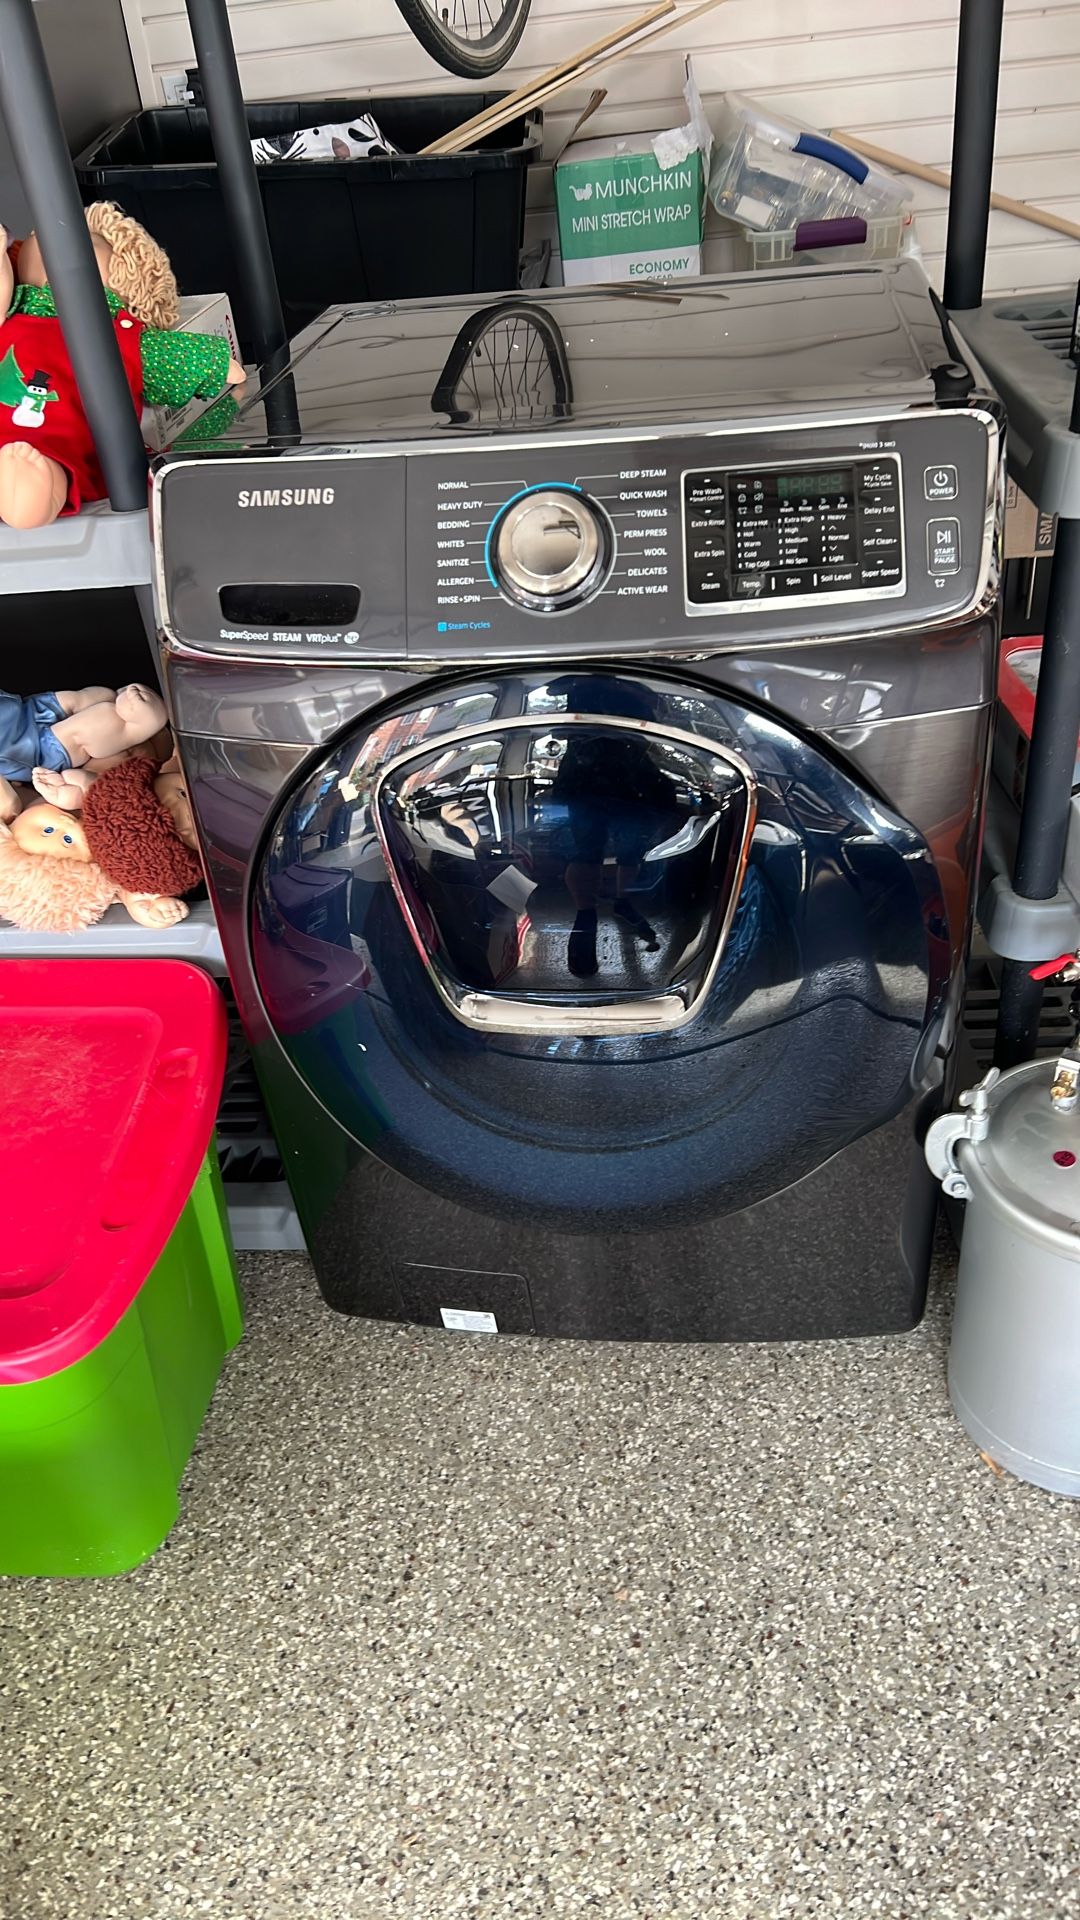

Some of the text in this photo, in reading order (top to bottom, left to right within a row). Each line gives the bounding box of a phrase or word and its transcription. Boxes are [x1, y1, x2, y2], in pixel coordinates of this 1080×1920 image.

[595, 170, 692, 199] MUNCHKIN
[572, 204, 692, 233] MINI STRETCH WRAP
[629, 258, 690, 275] ECONOMY
[620, 469, 667, 479] DEEP STEAM
[437, 481, 469, 490] NORMAL
[619, 490, 667, 500] QUICK WASH
[704, 487, 722, 495] Wash
[929, 487, 954, 495] POWER
[237, 487, 335, 508] SAMSUNG
[437, 501, 483, 511] HEAVY DUTY
[864, 505, 895, 515] Delay End
[636, 508, 668, 518] TOWELS
[437, 520, 470, 529] BEDDING
[691, 520, 708, 528] Extra
[623, 528, 668, 538] PERM PRESS
[437, 540, 465, 549] WHITES
[863, 538, 875, 546] Self
[643, 548, 667, 557] WOOL
[711, 550, 725, 558] Spin
[934, 547, 955, 555] START
[437, 558, 470, 568] SANITIZE
[934, 556, 955, 564] PAUSE
[627, 567, 668, 577] DELICATES
[861, 568, 899, 578] Super Speed
[437, 577, 475, 586] ALLERGEN
[786, 577, 801, 585] Spin
[821, 573, 852, 582] Soil Level
[617, 585, 668, 595] ACTIVE WEAR
[701, 582, 721, 591] Steam
[448, 621, 491, 631] Steam Cycles
[219, 628, 269, 641] SuperSpeed
[272, 632, 302, 642] STEAM
